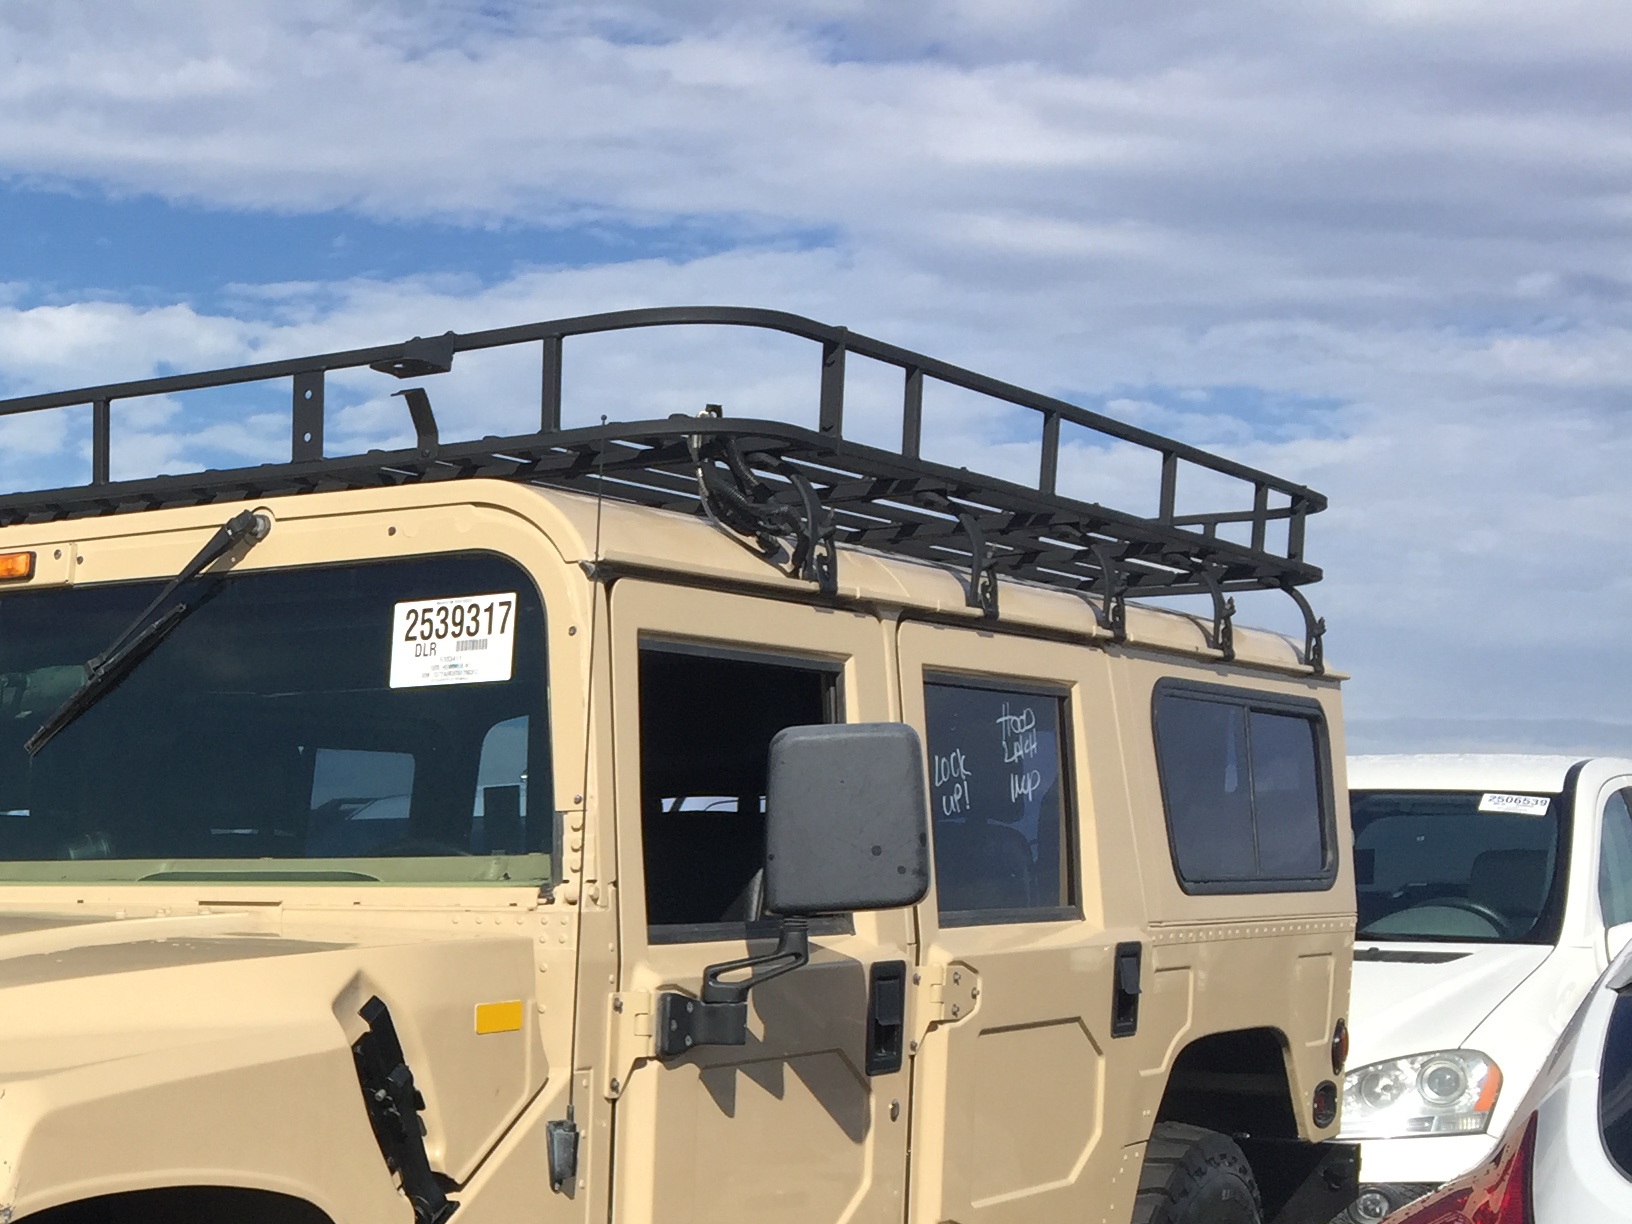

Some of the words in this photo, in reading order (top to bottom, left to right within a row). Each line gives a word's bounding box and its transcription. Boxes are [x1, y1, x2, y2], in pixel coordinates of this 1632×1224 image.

[405, 601, 512, 641] 2539317
[415, 642, 437, 657] DLR
[996, 702, 1036, 741] HOOD
[934, 748, 972, 787] LOCK
[942, 781, 970, 815] UP!
